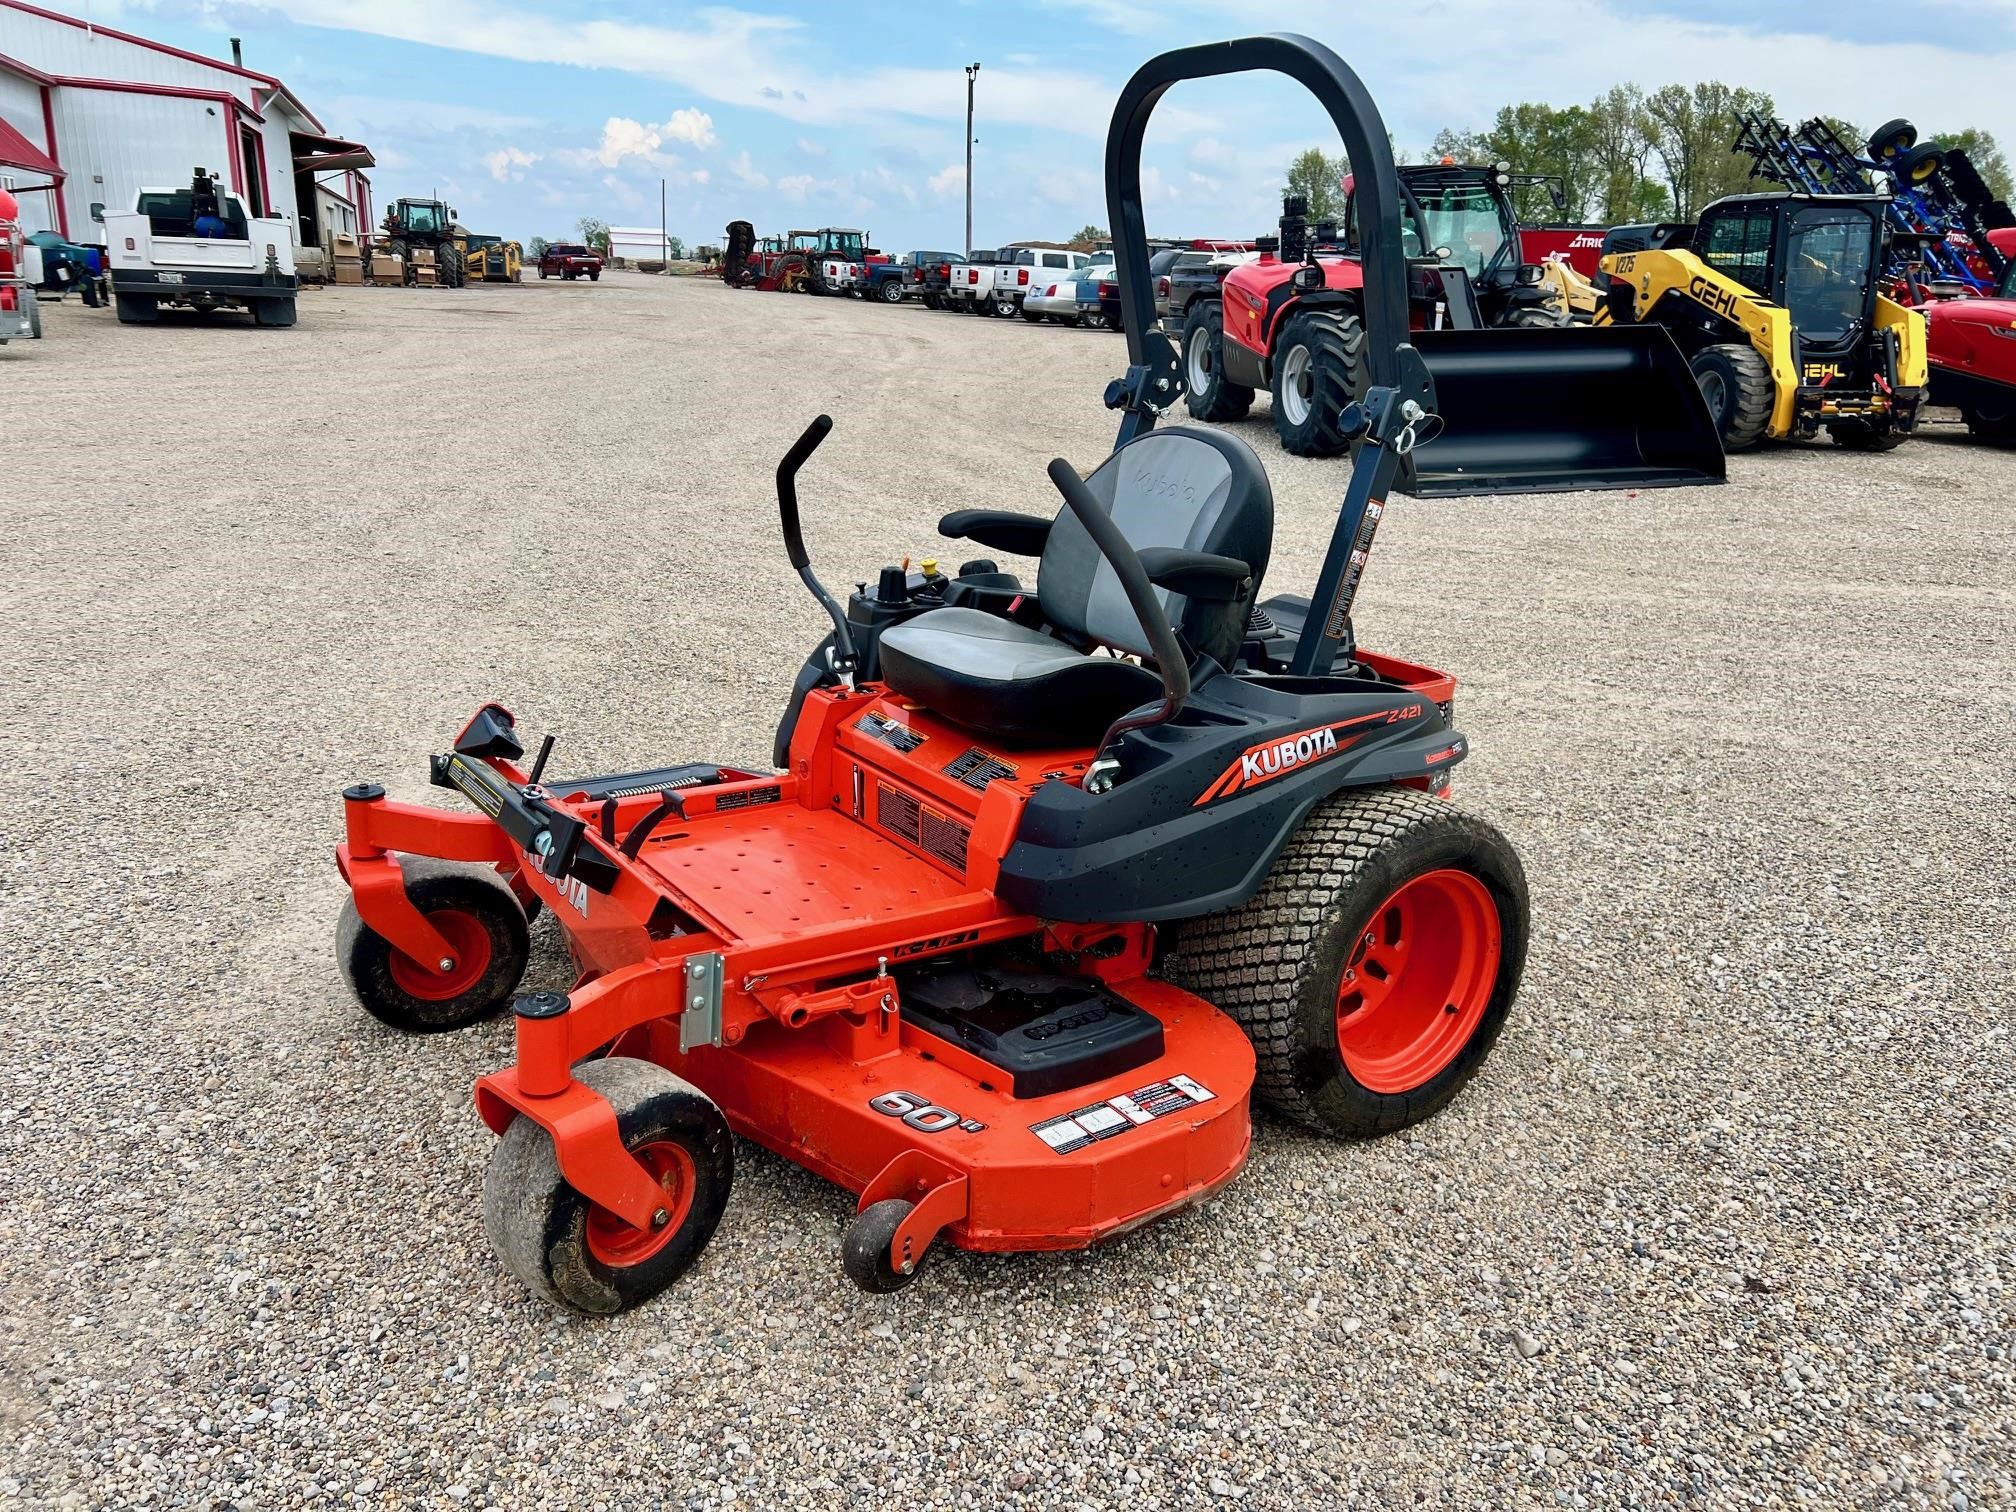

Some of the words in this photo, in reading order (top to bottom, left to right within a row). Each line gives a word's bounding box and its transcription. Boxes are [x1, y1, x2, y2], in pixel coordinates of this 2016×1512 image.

[1615, 254, 1637, 274] V275
[1690, 275, 1741, 322] GEHL
[1386, 704, 1423, 725] Z421
[1240, 726, 1339, 782] KUBOTA
[522, 848, 588, 920] UOTA
